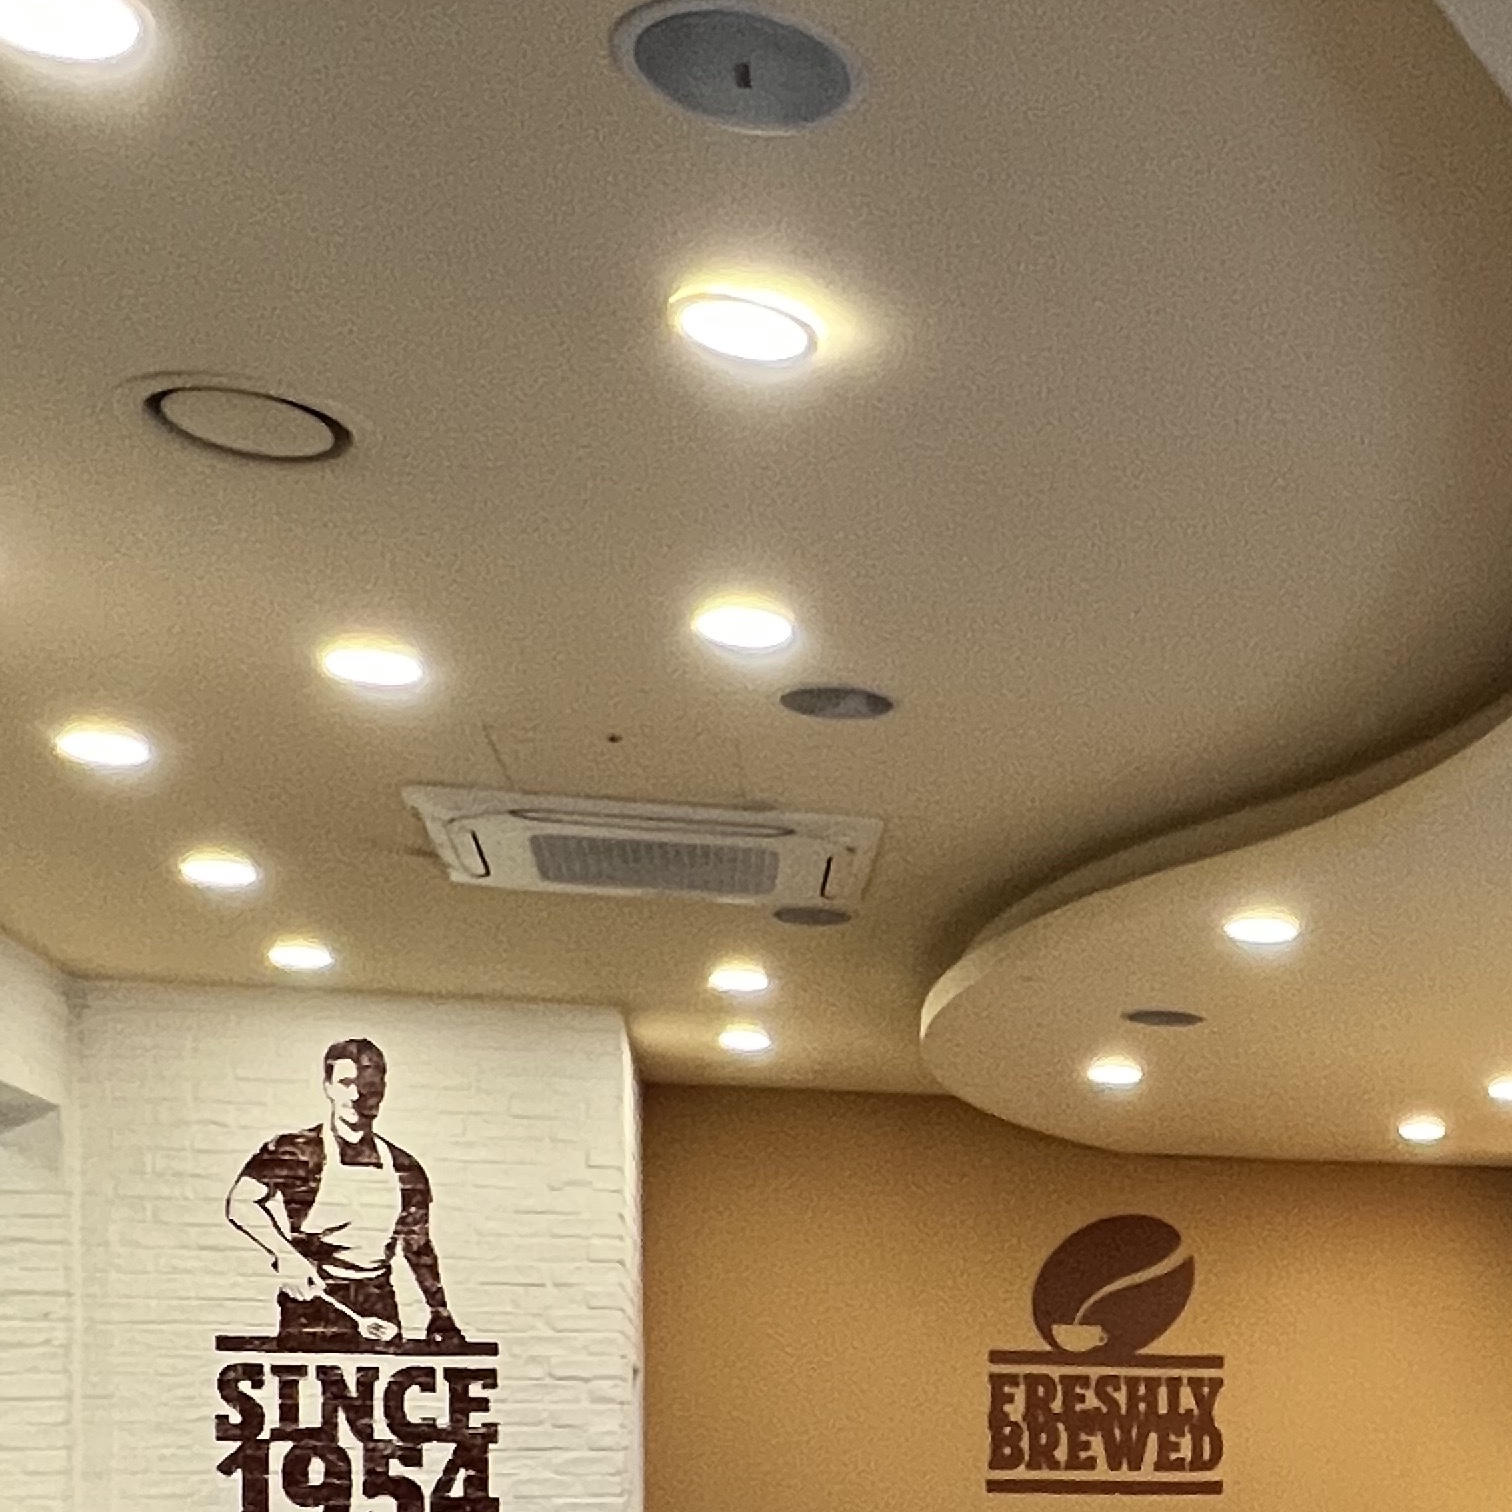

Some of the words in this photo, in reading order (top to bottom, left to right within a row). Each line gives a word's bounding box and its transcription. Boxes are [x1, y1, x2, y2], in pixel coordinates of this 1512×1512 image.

[215, 1363, 499, 1443] SINCE
[988, 1373, 1224, 1418] FRESHLY
[988, 1416, 1224, 1471] BREWED
